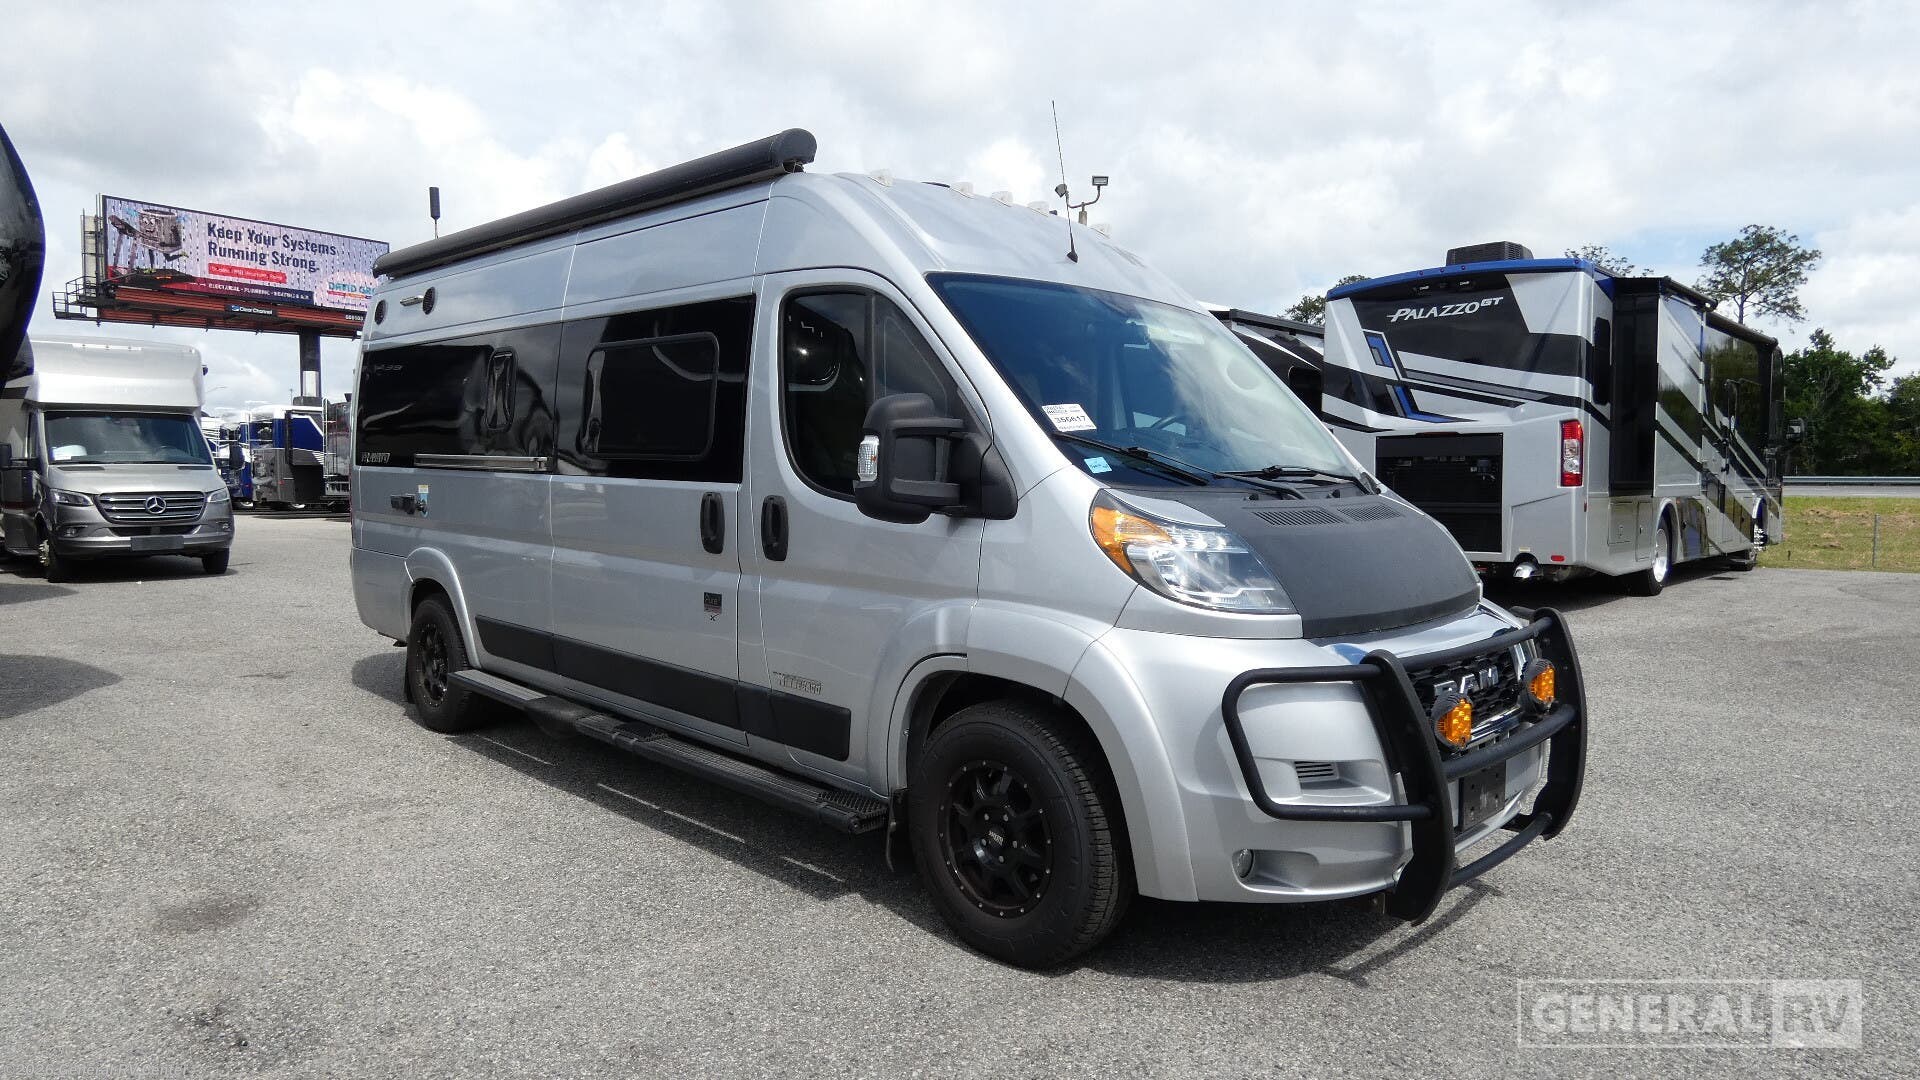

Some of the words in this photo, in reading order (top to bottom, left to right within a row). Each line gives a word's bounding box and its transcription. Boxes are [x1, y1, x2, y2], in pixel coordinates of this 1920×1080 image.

[207, 221, 242, 243] Keep
[248, 228, 277, 247] Your
[282, 234, 337, 255] Systems
[208, 240, 267, 265] Running
[271, 251, 320, 273] Strong.
[1386, 301, 1480, 323] PALAZZO
[1480, 296, 1504, 307] GT
